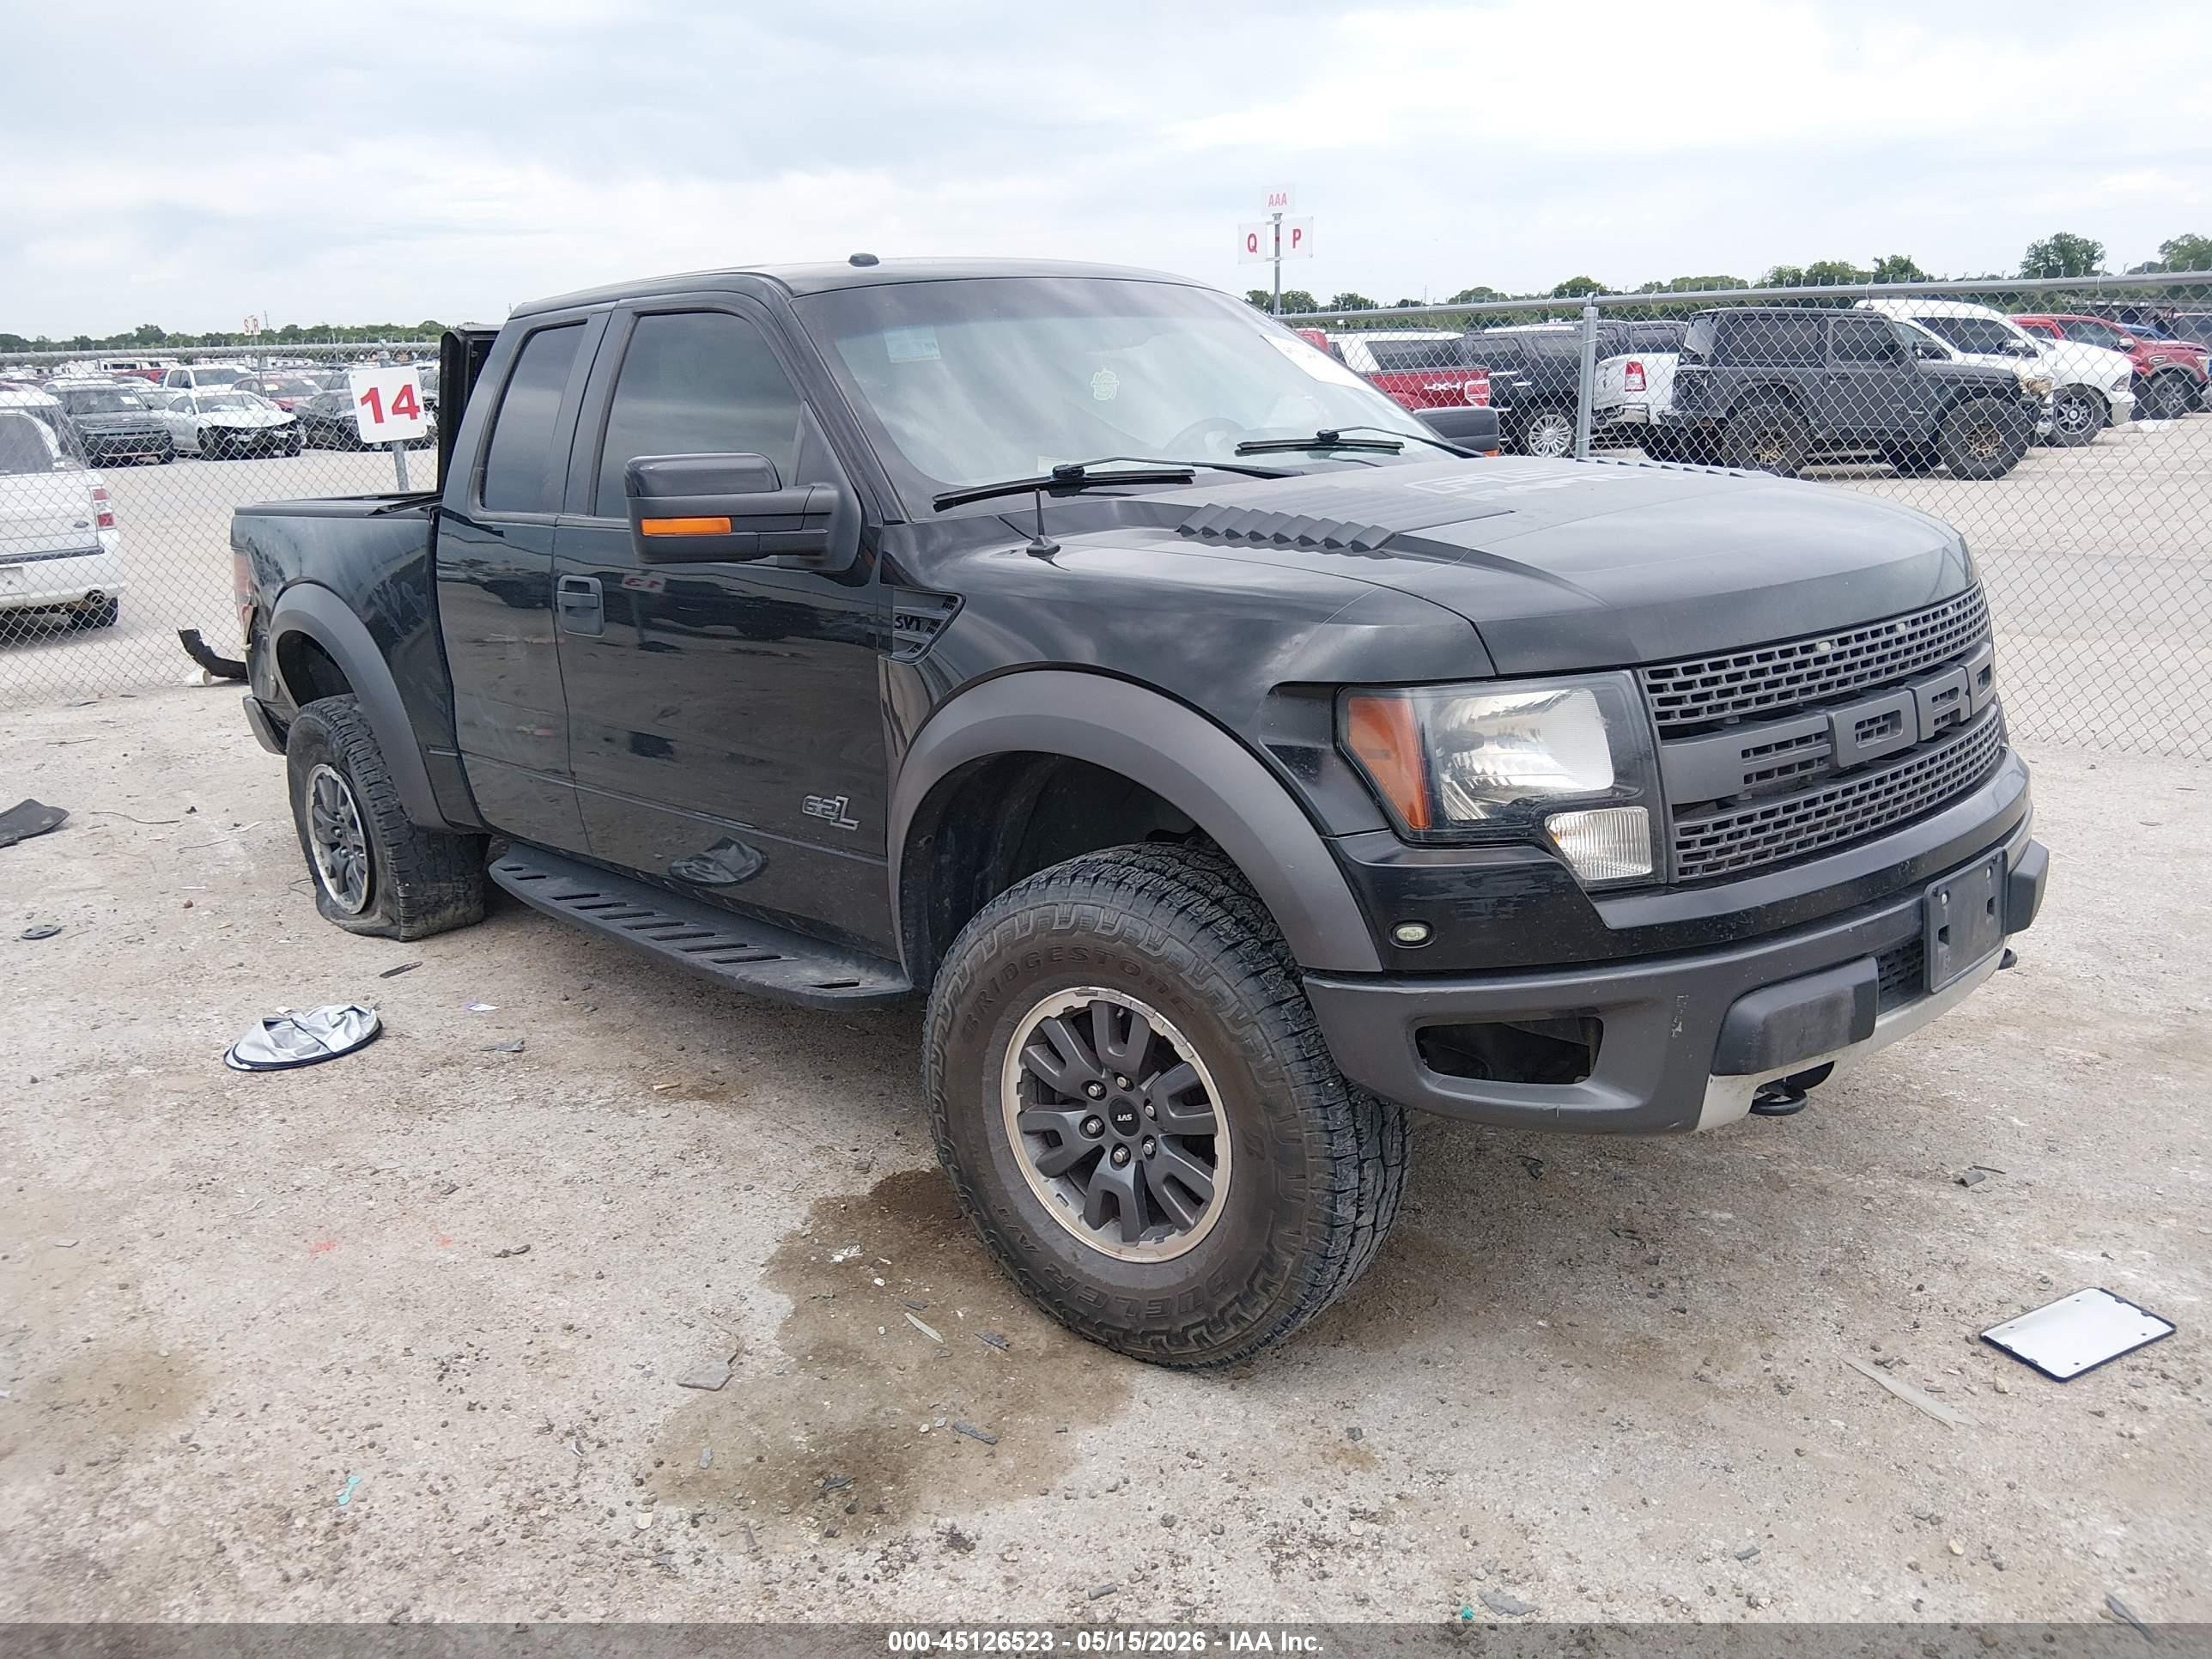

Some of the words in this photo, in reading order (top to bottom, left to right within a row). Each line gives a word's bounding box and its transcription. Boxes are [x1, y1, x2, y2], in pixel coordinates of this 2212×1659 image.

[1268, 192, 1287, 208] AAA
[1247, 233, 1258, 254] Q
[1291, 228, 1302, 249] P
[244, 319, 249, 334] S
[253, 318, 259, 334] R
[360, 384, 421, 424] 14
[894, 615, 922, 633] SVT
[1662, 642, 1996, 805] FORD
[961, 944, 1197, 1042] BRIDGESTONE
